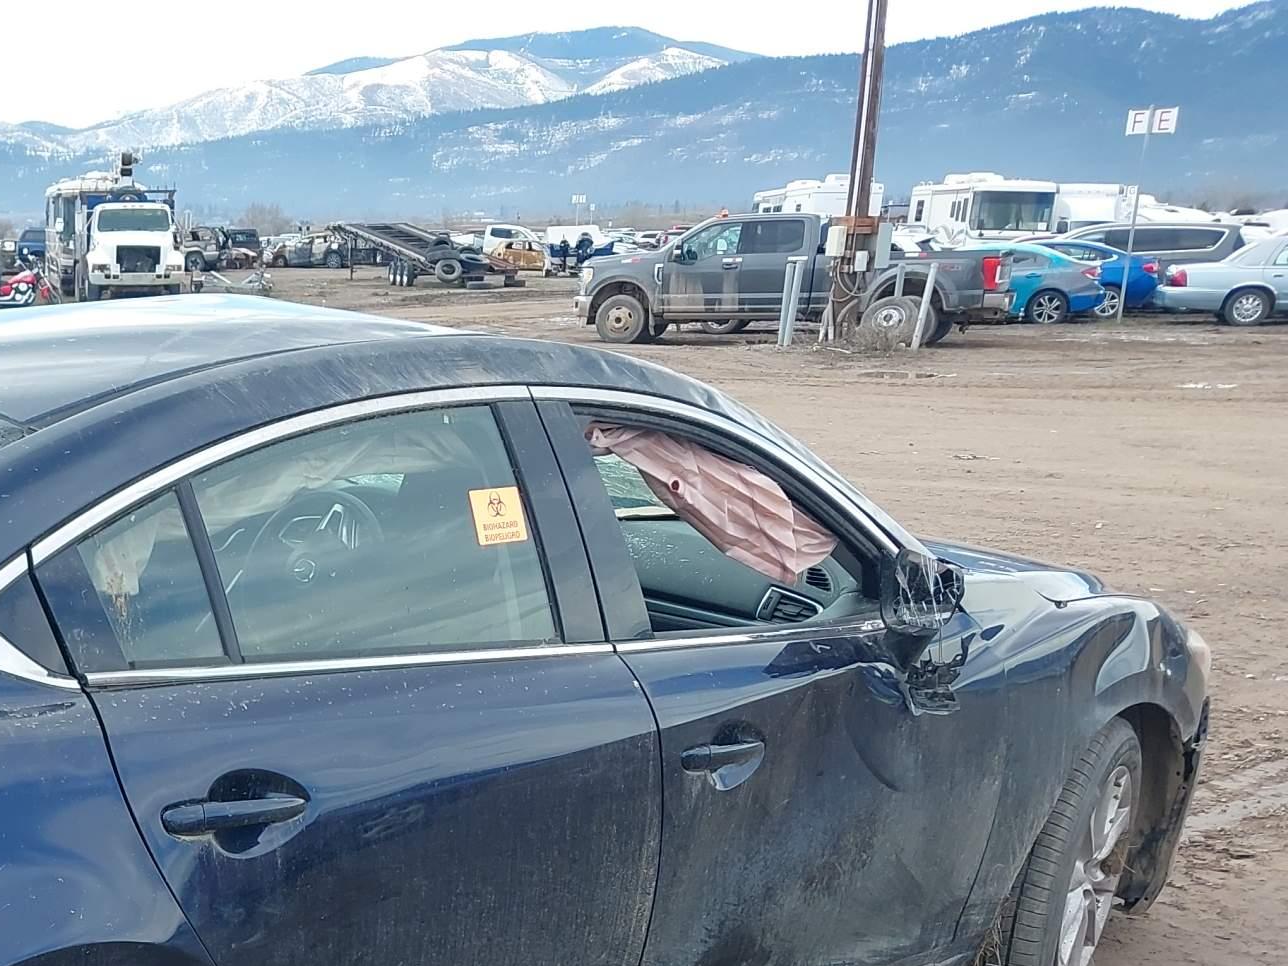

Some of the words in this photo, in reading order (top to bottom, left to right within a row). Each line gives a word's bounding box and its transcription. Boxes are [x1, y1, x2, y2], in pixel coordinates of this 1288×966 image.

[1132, 112, 1146, 133] F
[1158, 110, 1172, 131] E
[483, 520, 519, 531] BIOHAZARD
[485, 531, 521, 542] BIOPELIGRO
